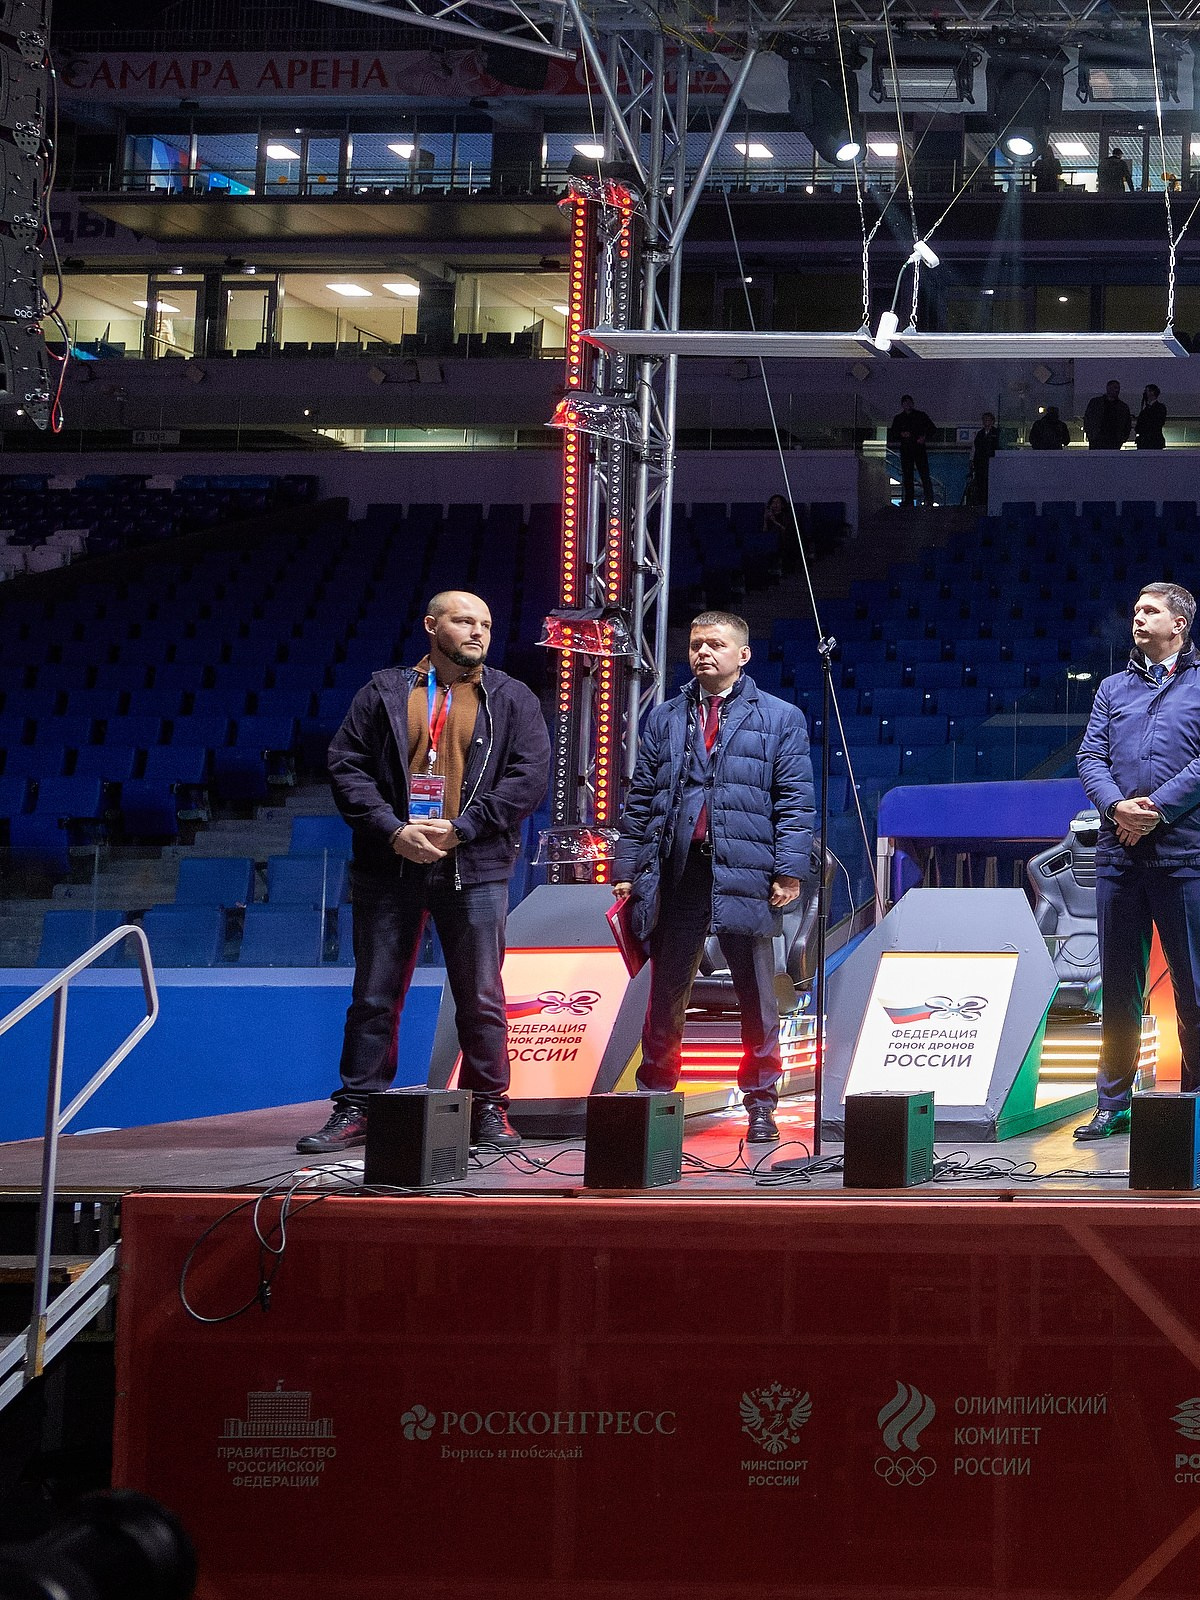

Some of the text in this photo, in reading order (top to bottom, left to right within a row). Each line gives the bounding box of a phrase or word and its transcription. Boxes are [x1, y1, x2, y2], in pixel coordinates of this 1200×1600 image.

[62, 58, 390, 90] САМАРА АРЕНА
[507, 1036, 582, 1046] НОК ДРОНОВ
[891, 1029, 978, 1040] ФЕДЕРАЦИЯ
[888, 1042, 975, 1051] ГОНОК ДРОНОВ
[507, 1048, 578, 1062] ОССИИ
[883, 1053, 973, 1068] РОССИИ
[953, 1393, 1107, 1415] ОЛИМПИЙСКИЙ
[440, 1410, 677, 1436] РОСКОНГРЕСС
[953, 1428, 1041, 1446] КОМИТЕТ
[217, 1446, 337, 1460] ПРАВИТЕЛЬСТВО
[440, 1443, 584, 1461] Борись и побеждай
[227, 1459, 326, 1474] РОССИЙСКОЙ
[740, 1459, 809, 1471] МИНСПОРТ
[953, 1458, 1032, 1476] РОССИИ
[232, 1474, 320, 1489] ФЕДЕРАЦИИ
[748, 1475, 800, 1487] РОССИИ
